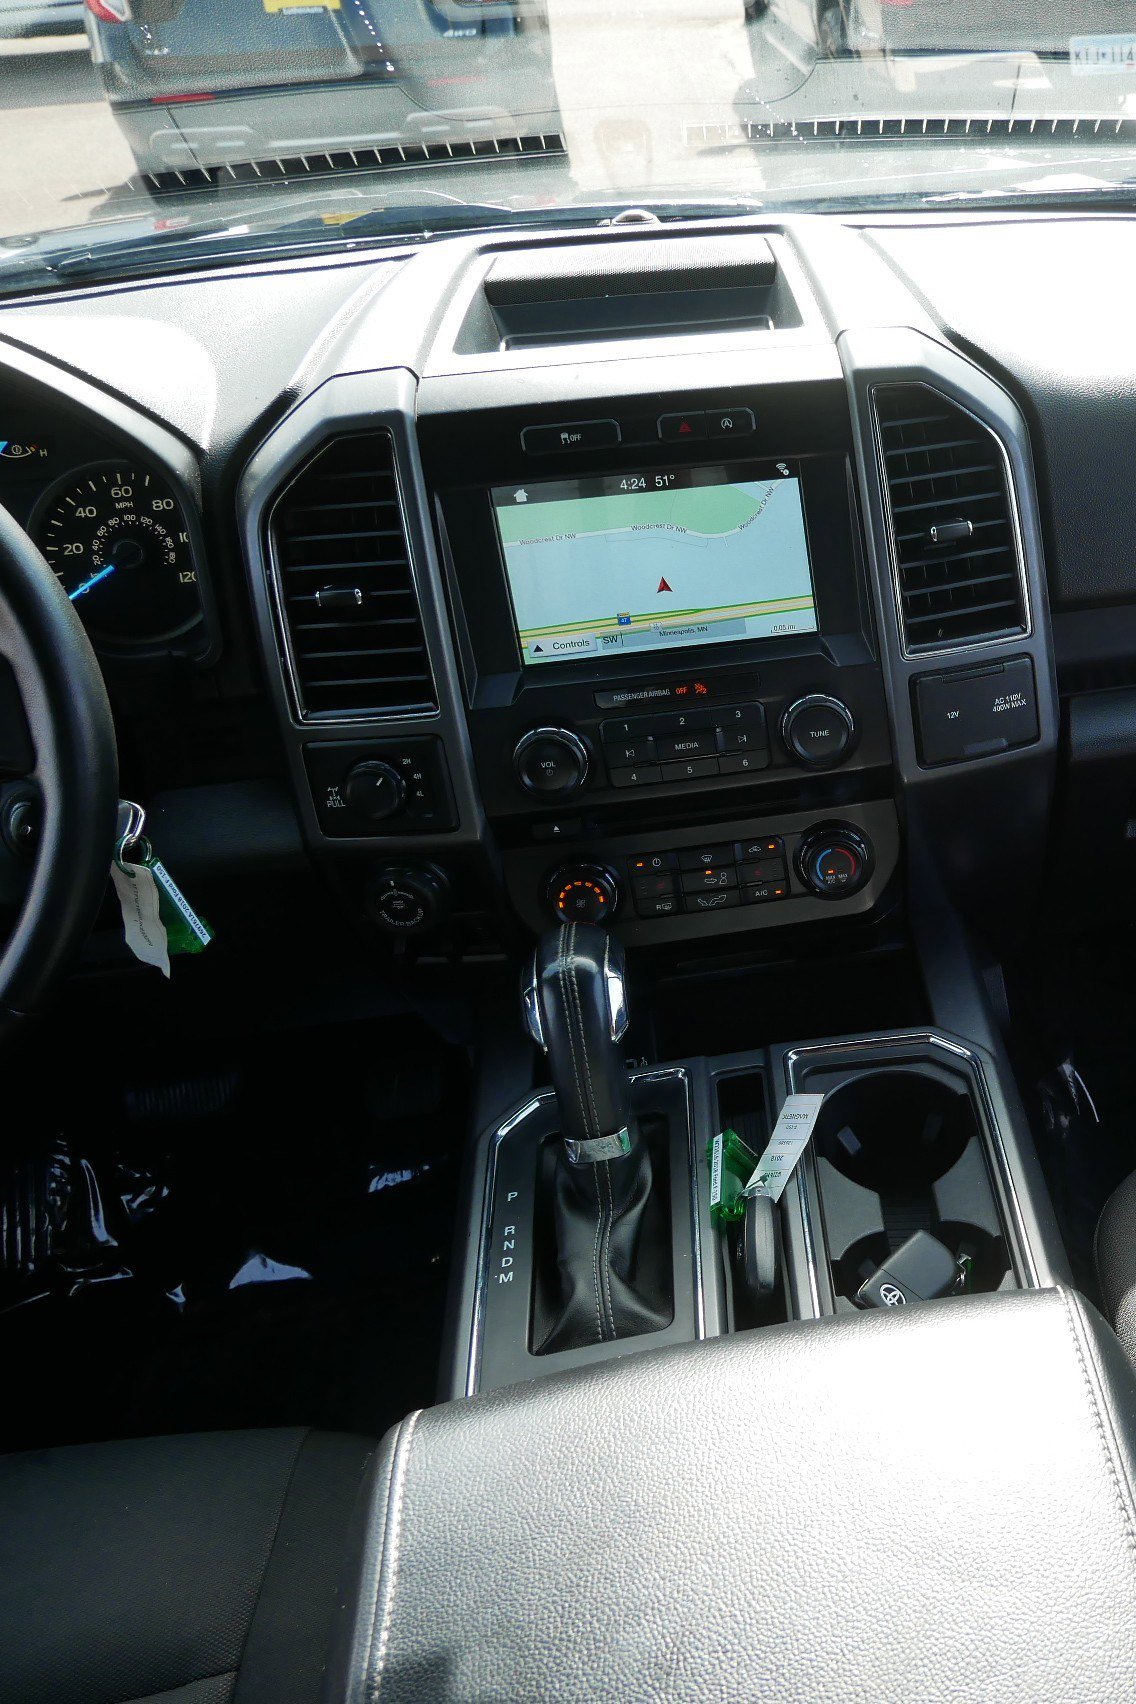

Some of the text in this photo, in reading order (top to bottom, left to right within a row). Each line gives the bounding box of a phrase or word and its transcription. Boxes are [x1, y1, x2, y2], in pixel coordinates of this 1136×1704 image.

[570, 434, 582, 442] OFF
[620, 478, 646, 490] 4:24
[111, 486, 132, 497] 60
[152, 498, 174, 510] 80
[75, 506, 97, 518] 40
[108, 518, 120, 526] 80
[140, 516, 152, 525] 120
[97, 526, 106, 536] 60
[154, 524, 166, 534] 140
[630, 523, 666, 532] Woodcrest
[675, 526, 688, 534] NW
[92, 540, 100, 550] 40
[166, 537, 174, 548] 160
[519, 536, 555, 546] Woodcrest
[556, 534, 564, 542] Dr
[63, 544, 84, 556] 20
[92, 555, 100, 566] 20
[168, 552, 176, 563] 180
[659, 628, 696, 637] Minneapolis,
[552, 639, 590, 650] Controls
[602, 636, 618, 644] SW
[613, 686, 688, 702] PASSENGER AIRBAG OFF
[994, 692, 1022, 706] AC 110V
[992, 698, 1026, 712] 400W MAX
[735, 710, 741, 718] 3
[946, 710, 960, 720] 12V
[624, 724, 628, 732] 1
[810, 730, 830, 738] TUNE
[674, 742, 699, 750] MEDIA
[540, 761, 556, 769] VOL
[687, 766, 693, 774] 5
[326, 800, 346, 808] PULL
[167, 882, 179, 897] Ford
[380, 908, 424, 927] TRAILER BACKUP
[508, 1192, 518, 1202] P
[504, 1226, 516, 1236] R
[503, 1240, 515, 1250] N
[501, 1257, 513, 1268] D
[499, 1272, 514, 1284] M
